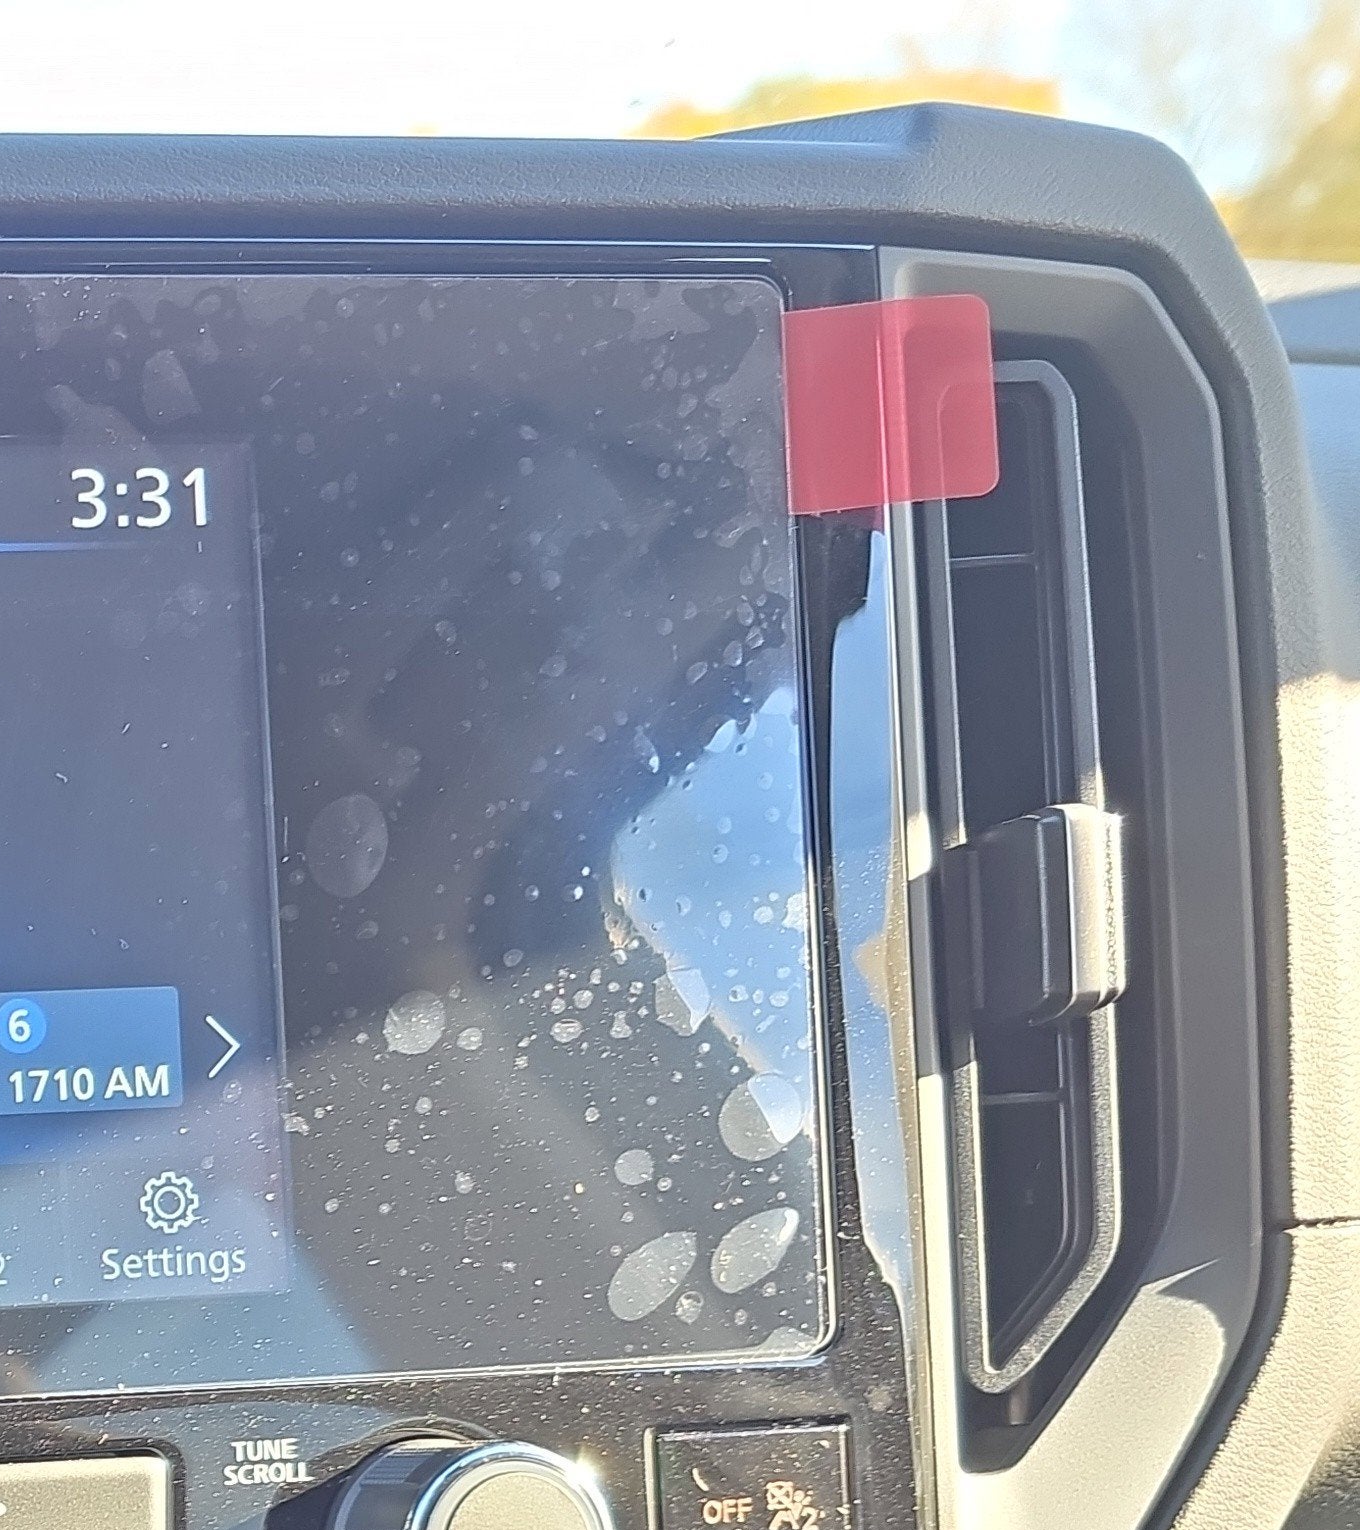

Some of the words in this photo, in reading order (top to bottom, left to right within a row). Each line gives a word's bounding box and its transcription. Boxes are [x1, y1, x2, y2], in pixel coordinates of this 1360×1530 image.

[70, 467, 211, 529] 3:31
[8, 1010, 31, 1043] 6
[7, 1069, 95, 1104] 1710
[104, 1065, 169, 1100] AM
[102, 1247, 247, 1284] Settings
[231, 1437, 299, 1462] TUNE
[223, 1461, 314, 1485] SCROLL
[702, 1498, 754, 1524] OFF
